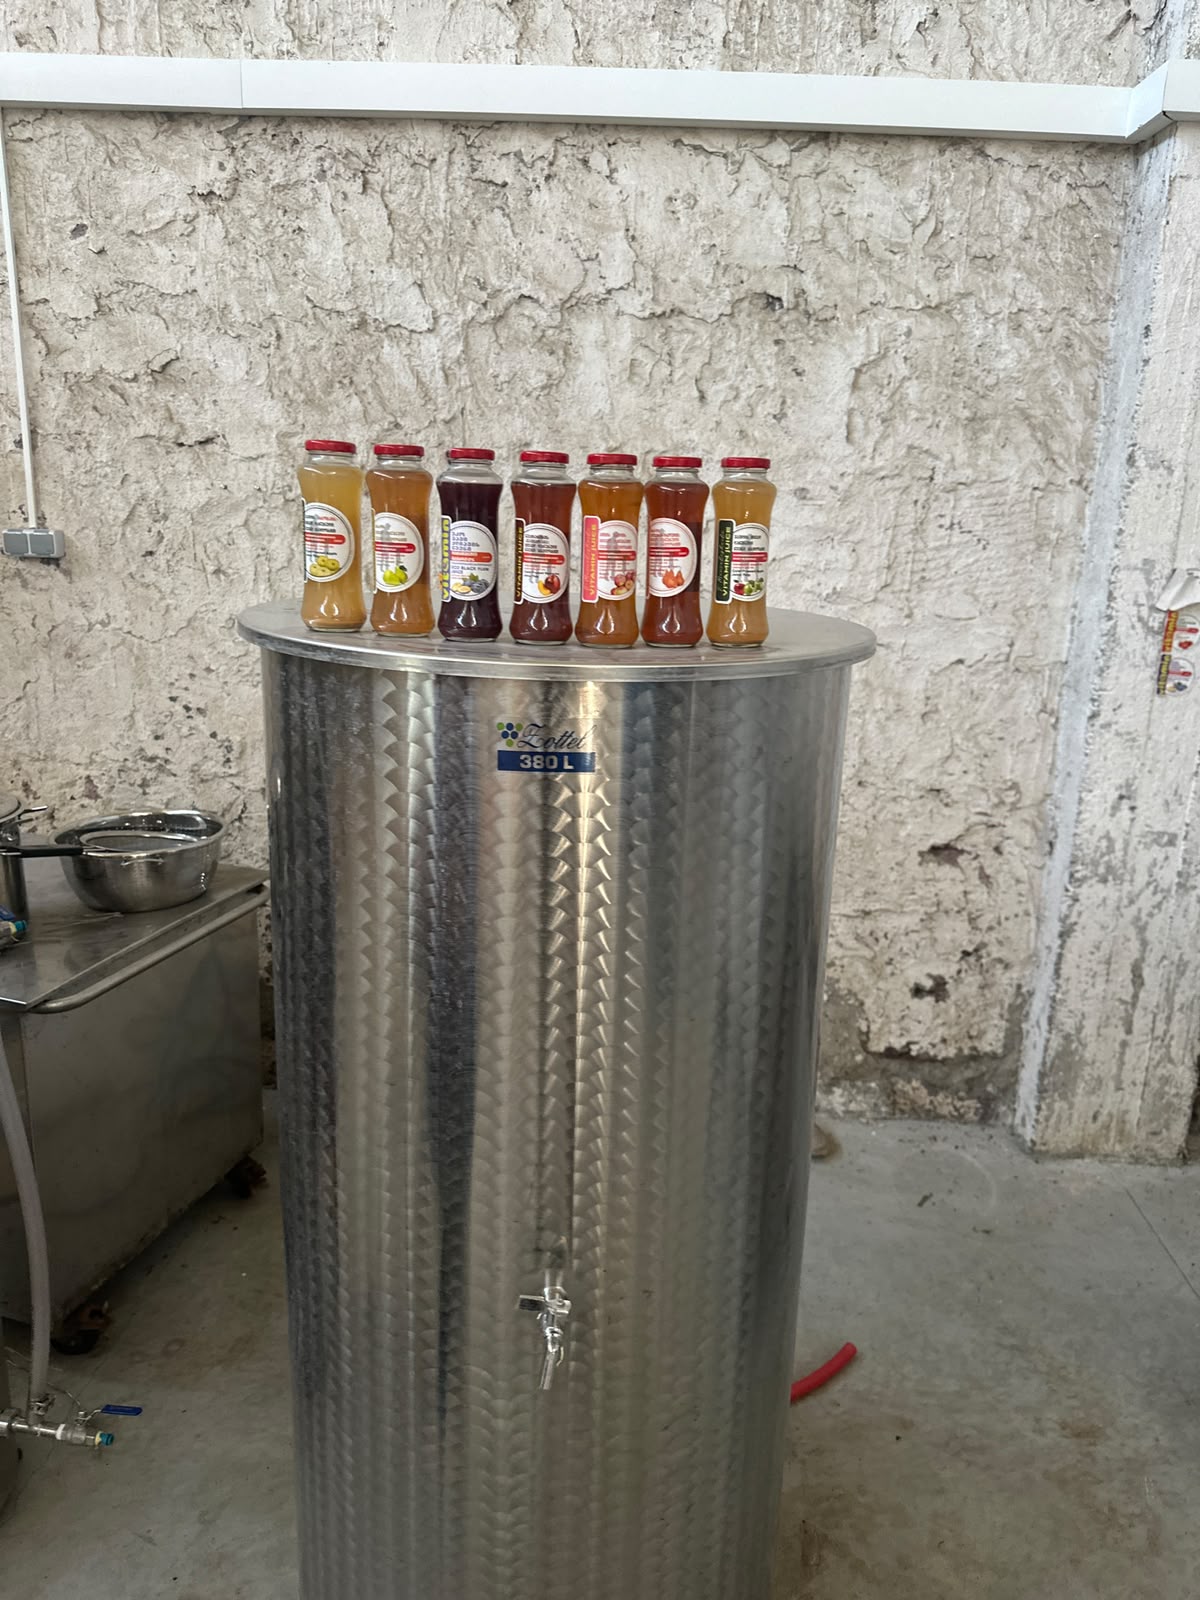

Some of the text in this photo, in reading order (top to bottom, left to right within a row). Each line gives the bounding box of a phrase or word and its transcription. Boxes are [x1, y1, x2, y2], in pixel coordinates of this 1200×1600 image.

[441, 519, 449, 600] vitamin
[722, 526, 732, 597] VITAMIN JUICE
[519, 754, 575, 770] 380 L
